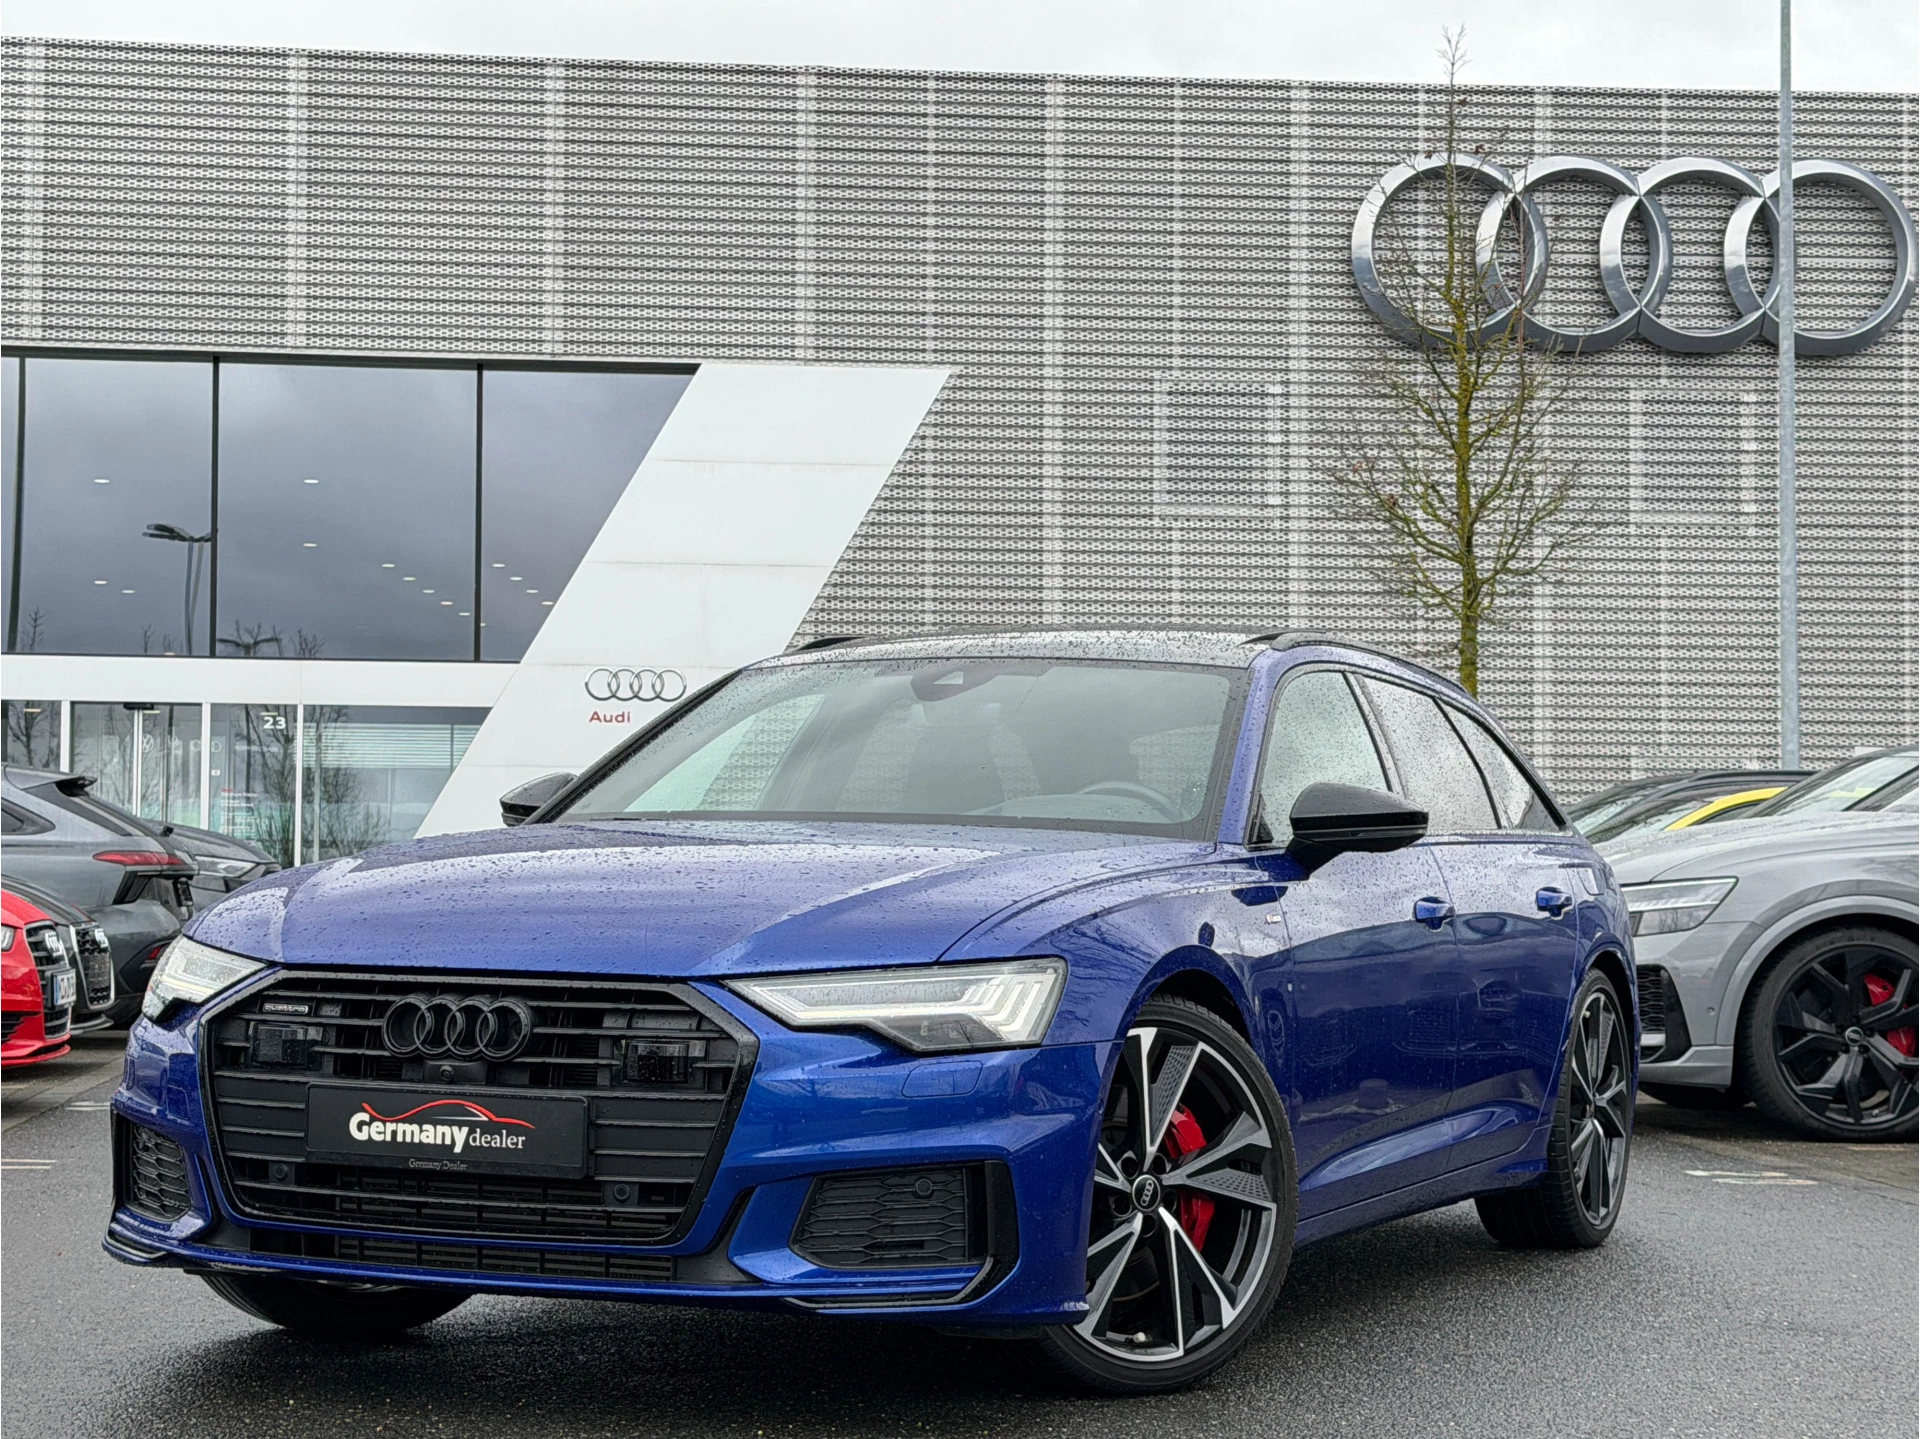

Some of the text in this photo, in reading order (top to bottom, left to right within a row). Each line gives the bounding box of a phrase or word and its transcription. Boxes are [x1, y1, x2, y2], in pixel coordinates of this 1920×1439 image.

[263, 717, 286, 729] 23
[589, 711, 631, 723] Audi
[408, 1158, 468, 1171] Germany Dealer
